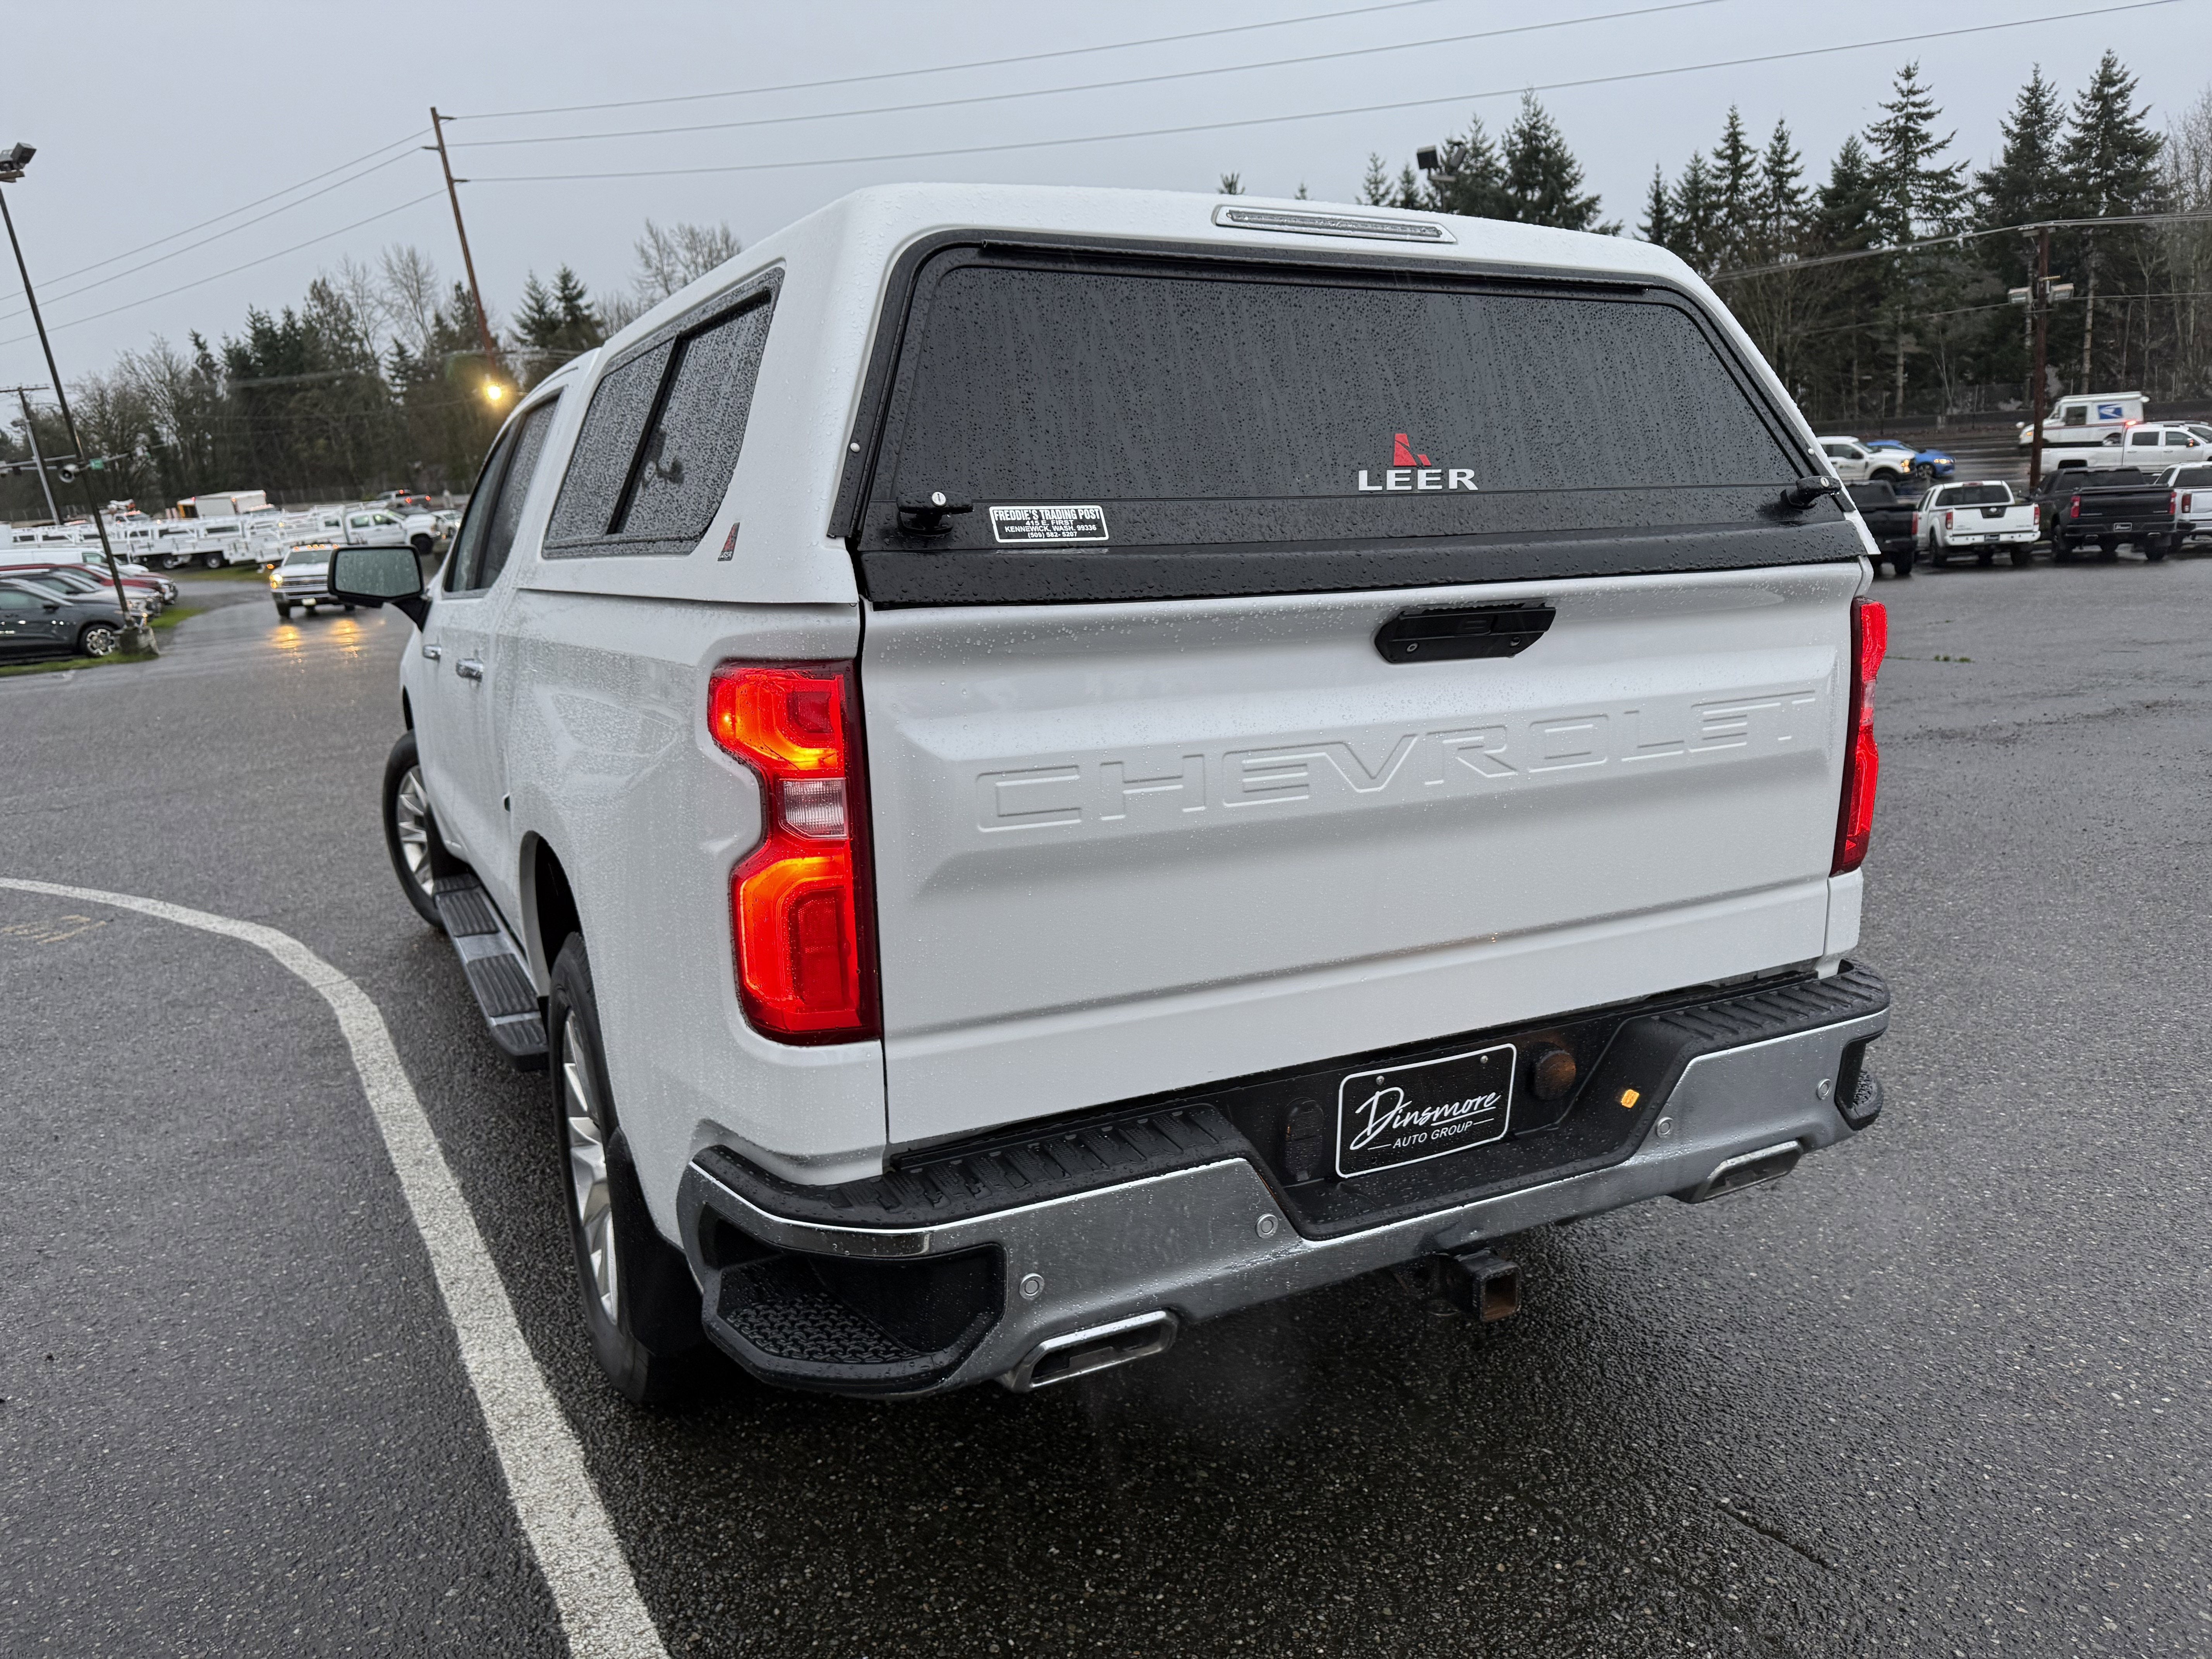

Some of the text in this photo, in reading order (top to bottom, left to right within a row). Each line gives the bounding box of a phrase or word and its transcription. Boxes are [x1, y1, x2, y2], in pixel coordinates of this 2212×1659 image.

[1358, 469, 1478, 491] LEER
[993, 508, 1100, 521] FREDDIE'S TRADING POST
[977, 689, 1816, 833] CHEVROLET
[1350, 1087, 1501, 1150] Dinsmore
[1393, 1121, 1473, 1149] AUTO GROUP
